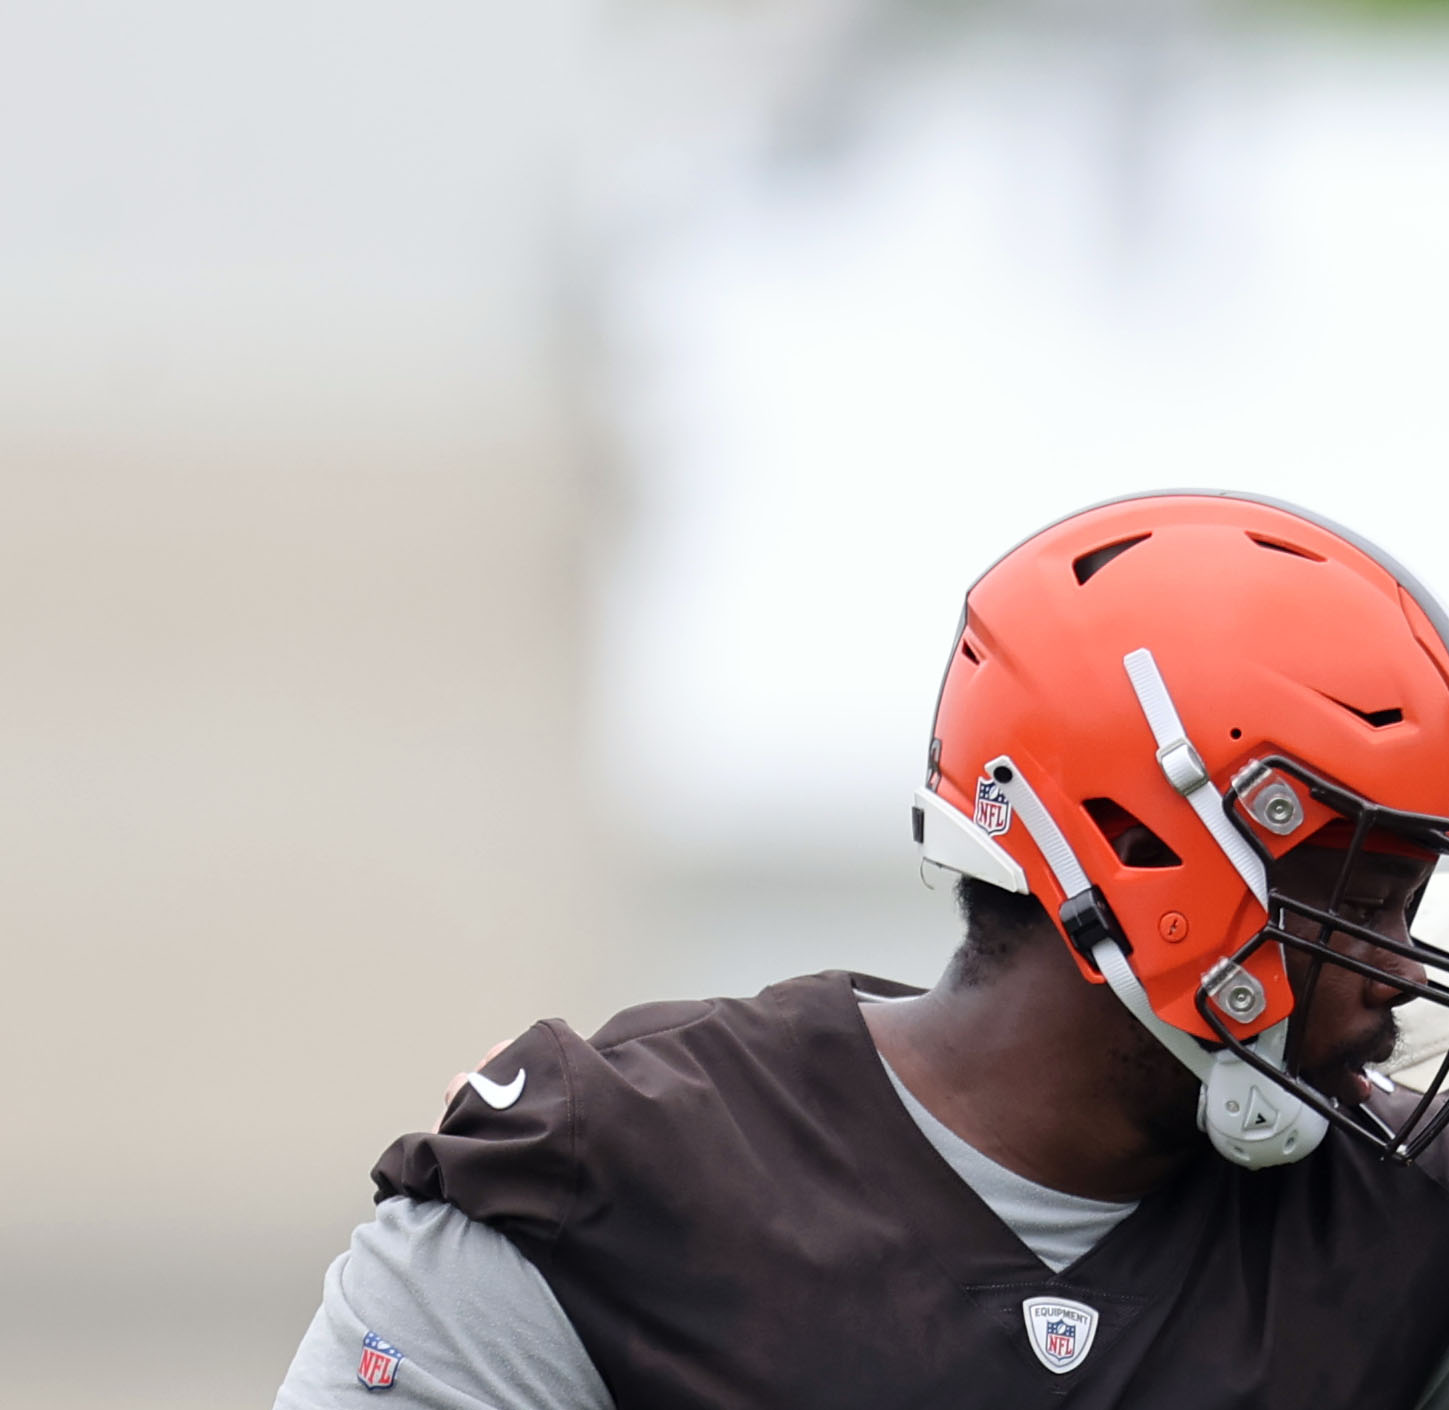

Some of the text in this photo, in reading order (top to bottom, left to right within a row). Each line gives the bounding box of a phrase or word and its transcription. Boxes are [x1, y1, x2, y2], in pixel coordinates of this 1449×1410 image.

[978, 801, 1004, 830] NFL
[1034, 1306, 1089, 1325] EQUIPMENT
[1047, 1335, 1073, 1357] NFL
[357, 1349, 393, 1385] NFL
